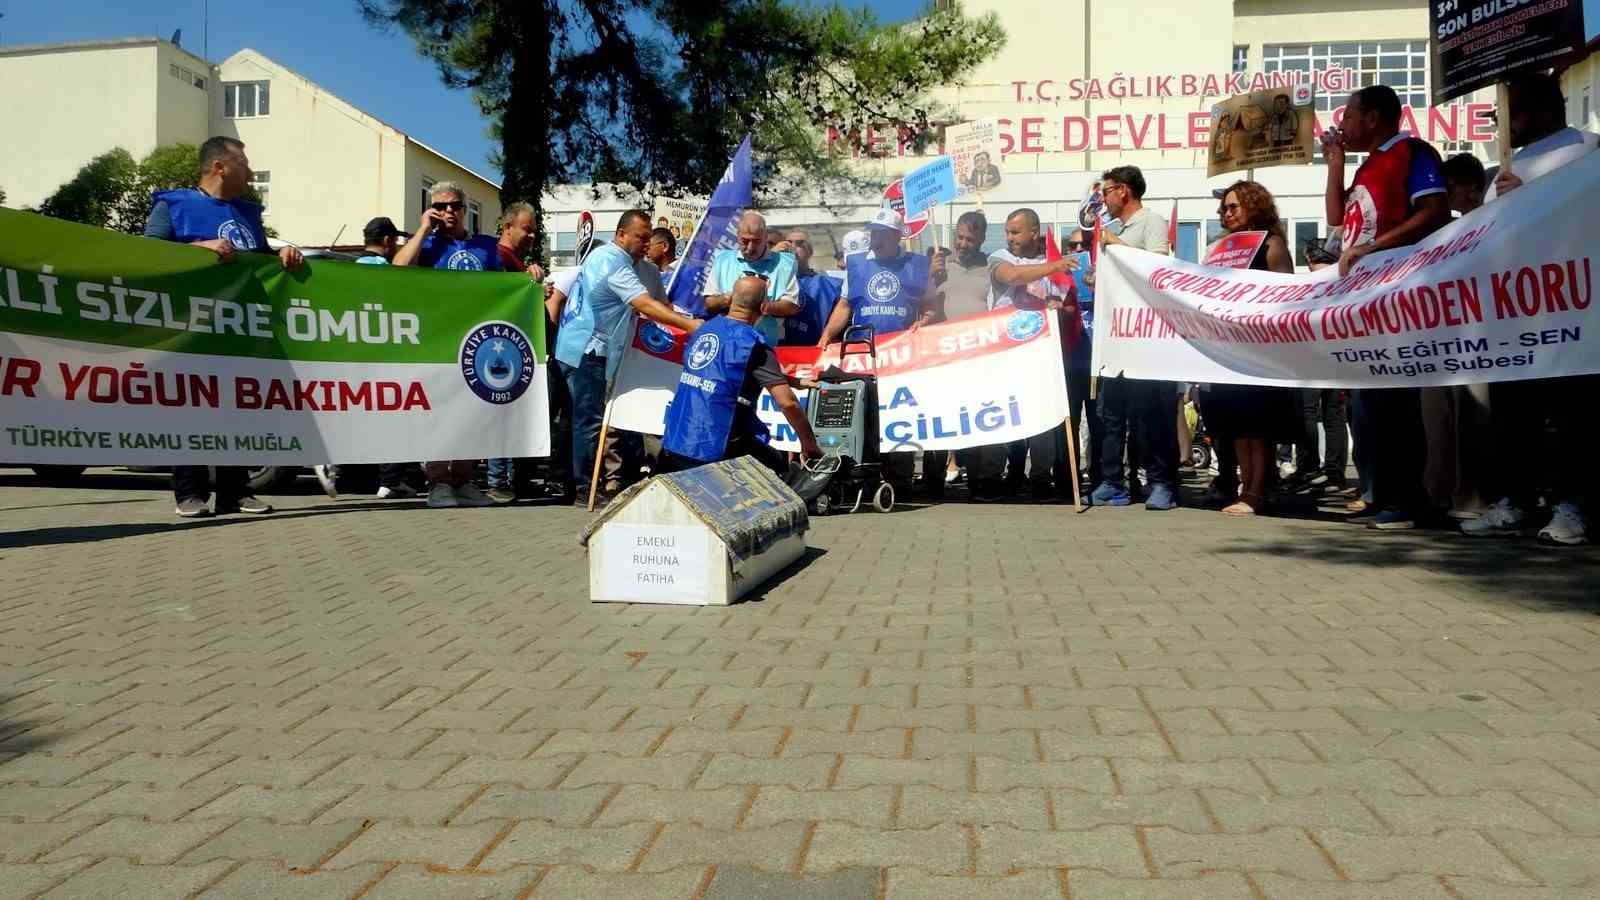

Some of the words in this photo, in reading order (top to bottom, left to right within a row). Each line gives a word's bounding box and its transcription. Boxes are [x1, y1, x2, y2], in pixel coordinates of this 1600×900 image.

[1437, 13, 1468, 40] SON
[1471, 0, 1531, 23] BULS
[1012, 79, 1062, 103] T.C.
[1068, 72, 1173, 101] SAĞLIK
[1063, 111, 1212, 152] DEVLE
[1150, 267, 1257, 302] MEMURLAR
[1248, 282, 1324, 304] YERDE
[1321, 276, 1483, 341] ZULMÜNDEN
[1491, 257, 1593, 320] KORU
[0, 264, 63, 315] Lİ
[76, 275, 274, 339] SİZLERE
[286, 302, 421, 345] ÖMÜR
[463, 328, 489, 387] TÜRKİYE
[493, 326, 532, 384] KAMU-SEN
[938, 324, 1000, 354] SEN
[1332, 347, 1392, 364] TÜRK
[1399, 338, 1489, 359] EĞİTİM
[1519, 326, 1581, 347] SEN
[1369, 360, 1437, 377] Muğla
[1445, 350, 1534, 374] Şubesi
[58, 361, 219, 408] YOĞUN
[235, 377, 431, 411] BAKIMDA
[6, 424, 112, 449] TÜRKİYE
[119, 432, 182, 450] KAMU
[188, 434, 229, 451] SEN
[235, 432, 303, 452] MUĞLA
[633, 552, 680, 566] RUHUNA
[636, 535, 675, 548] EMEKLİ
[636, 572, 675, 585] FATİHA
